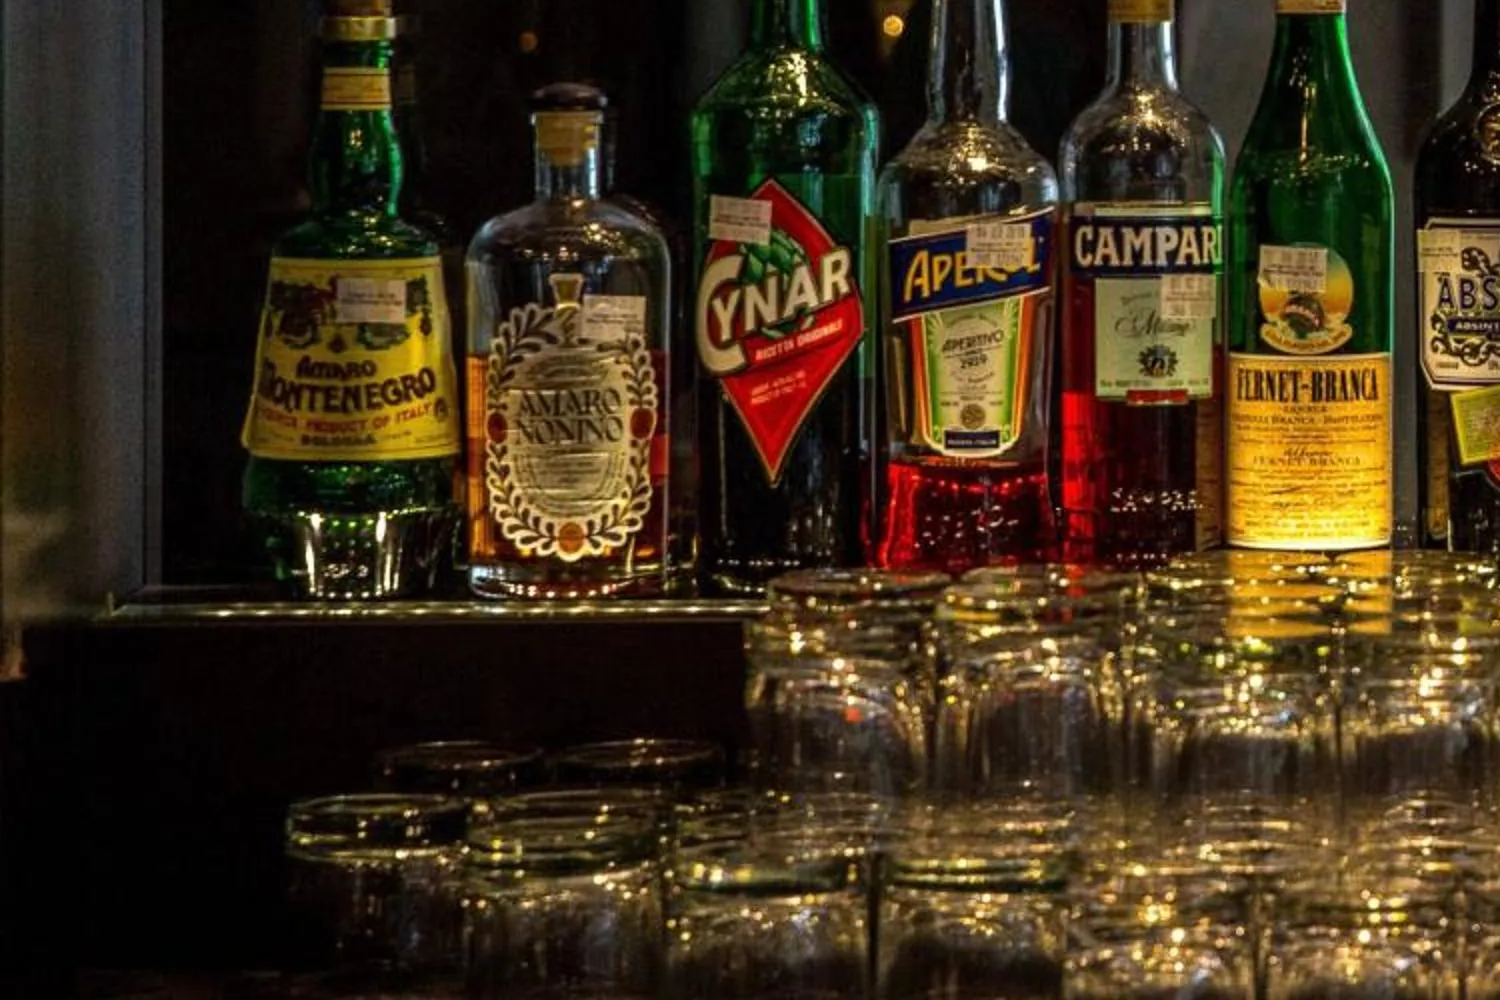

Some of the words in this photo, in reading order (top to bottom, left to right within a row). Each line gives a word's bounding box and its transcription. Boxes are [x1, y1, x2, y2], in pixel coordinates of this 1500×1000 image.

[1074, 225, 1222, 268] CAMPARI
[904, 236, 1041, 303] APEL
[694, 247, 852, 376] CYNAR
[518, 387, 621, 418] AMARO
[1236, 369, 1378, 402] FERNET-BRANCA
[516, 415, 624, 444] NONINO
